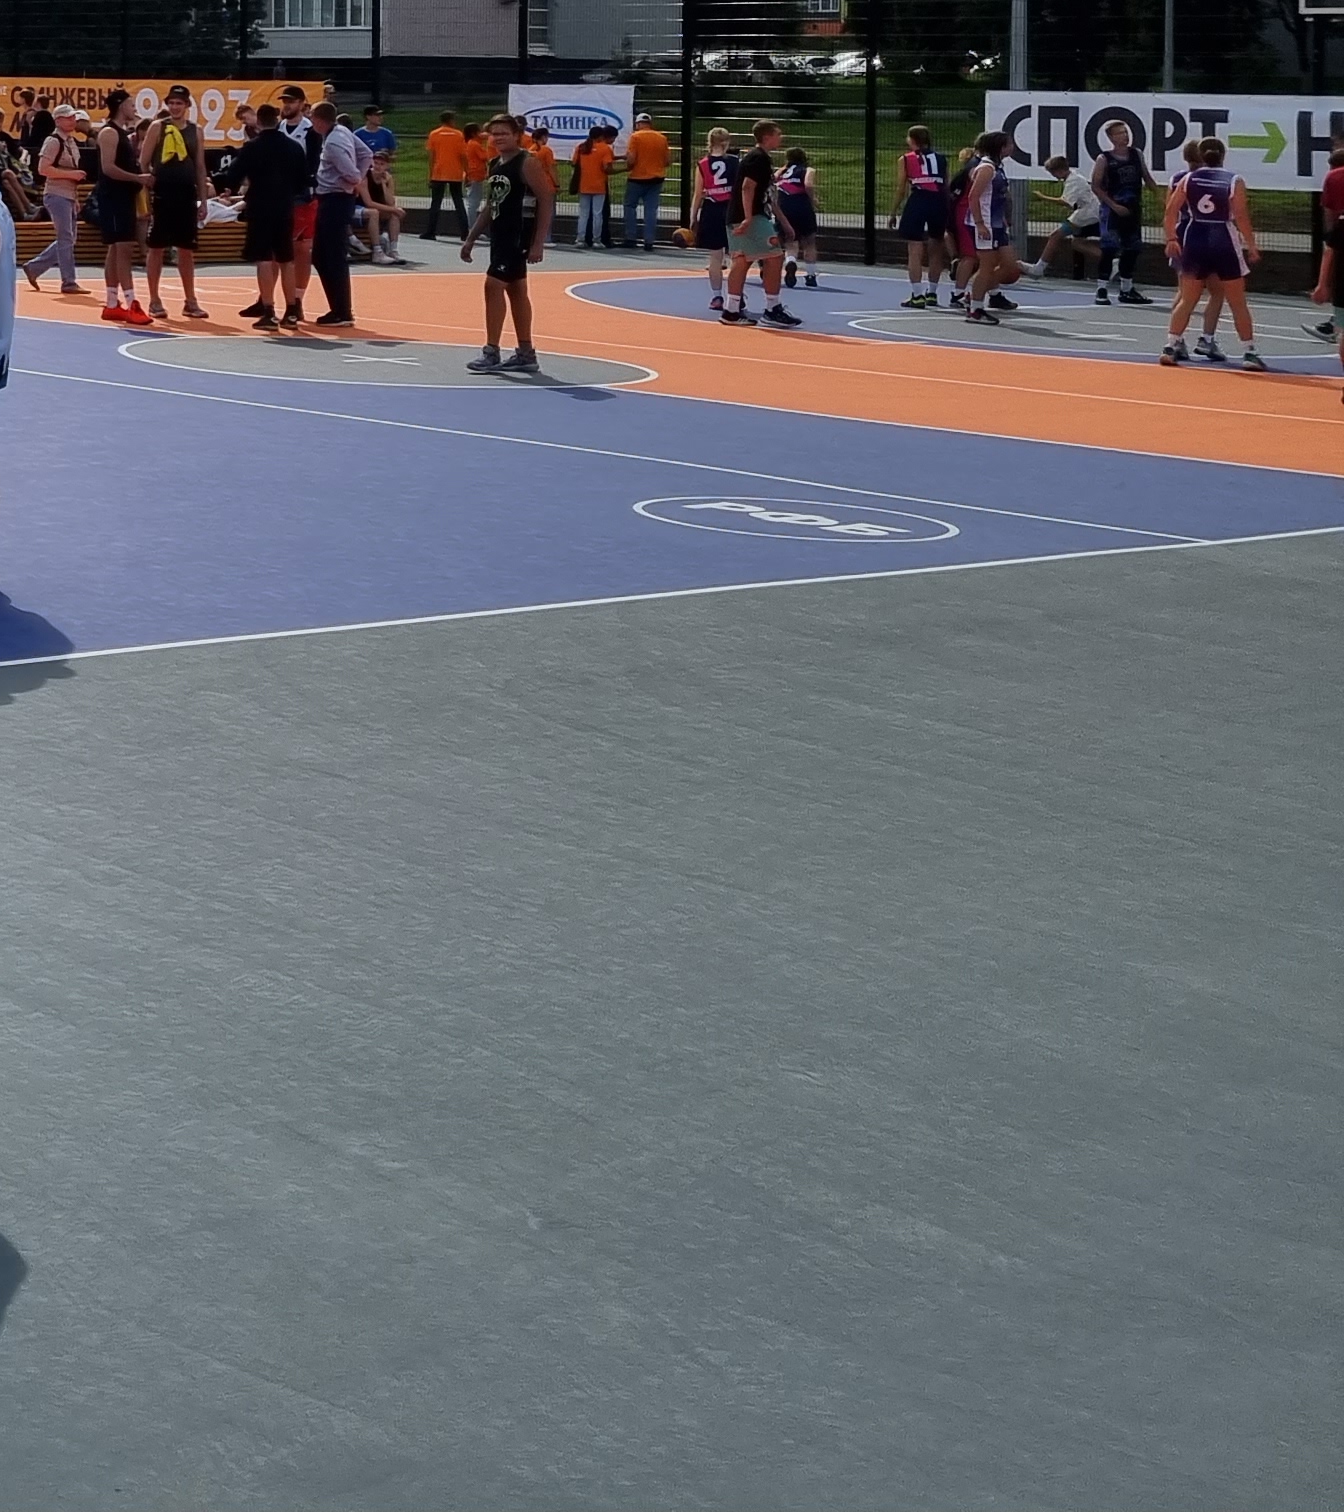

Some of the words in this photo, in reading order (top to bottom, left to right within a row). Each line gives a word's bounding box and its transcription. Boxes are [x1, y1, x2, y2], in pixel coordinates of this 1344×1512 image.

[531, 115, 609, 130] ТАЛИНКА
[1001, 104, 1229, 172] СПОРТ
[711, 160, 728, 186] 2
[1197, 193, 1215, 214] 6
[682, 501, 911, 537] РФБ
